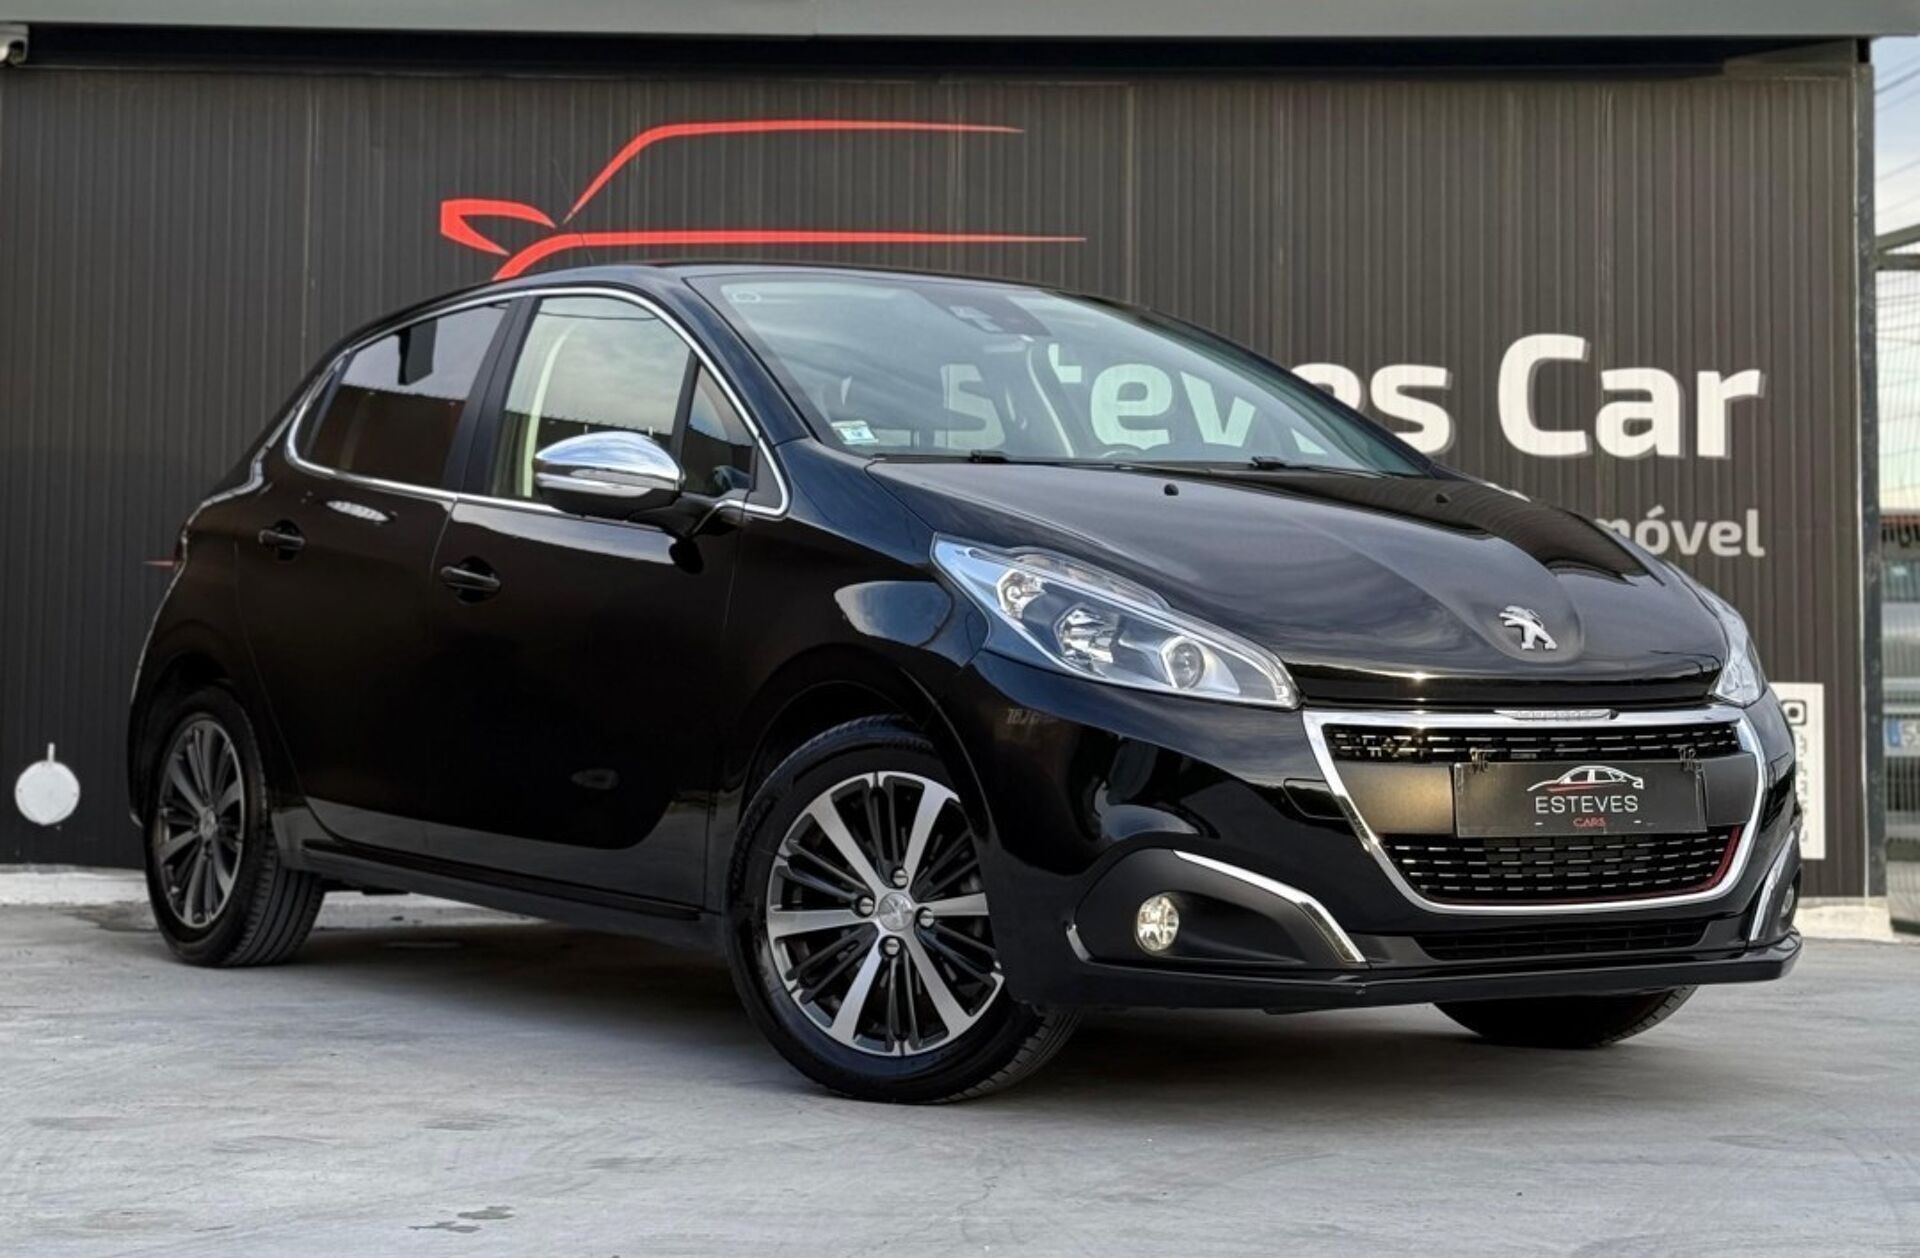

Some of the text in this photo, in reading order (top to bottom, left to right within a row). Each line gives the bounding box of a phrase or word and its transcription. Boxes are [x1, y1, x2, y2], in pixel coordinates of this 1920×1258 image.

[875, 333, 1762, 458] sevs Car
[1535, 795, 1639, 814] ESTEVES
[1572, 817, 1607, 828] CARS
